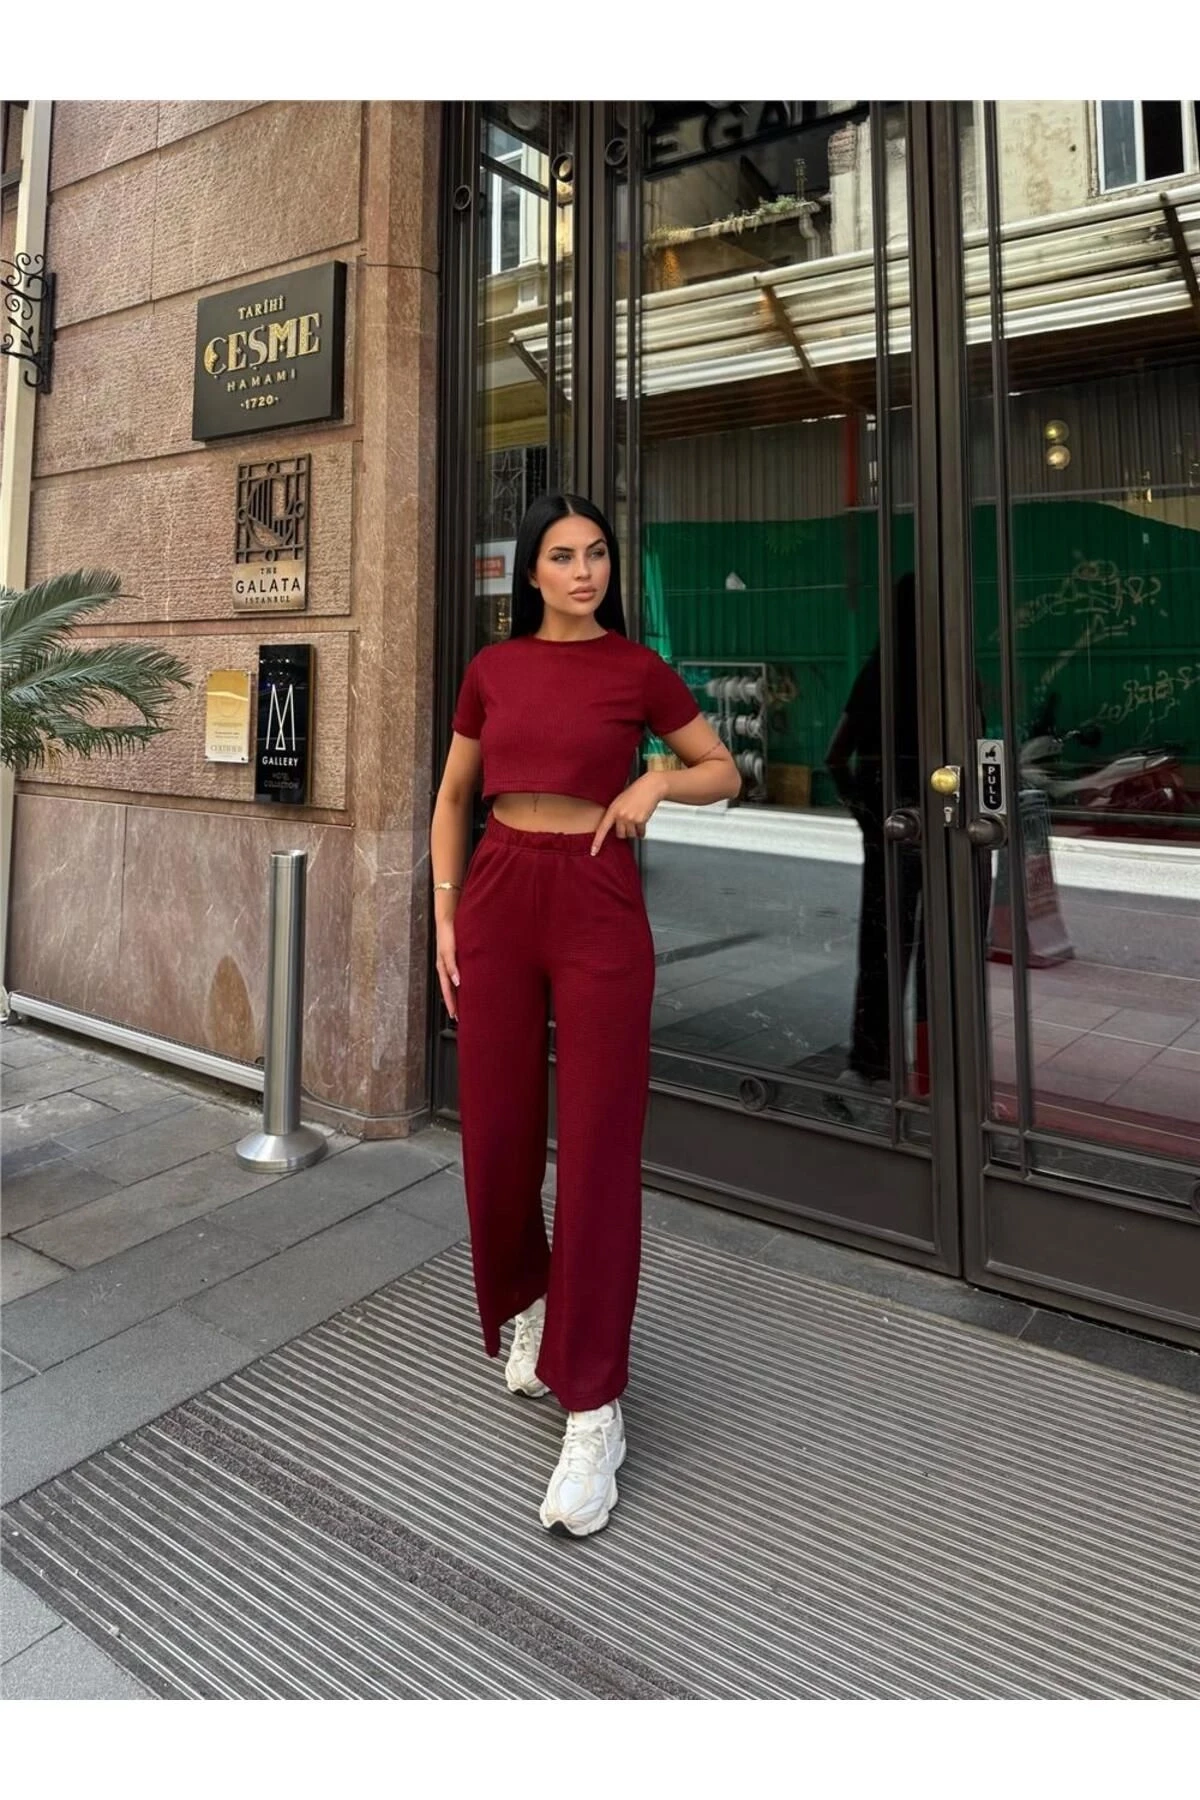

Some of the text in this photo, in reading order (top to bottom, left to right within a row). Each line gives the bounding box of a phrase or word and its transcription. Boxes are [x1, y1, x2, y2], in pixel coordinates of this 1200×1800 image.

[238, 295, 285, 320] TARİHİ
[203, 312, 321, 379] ÇEŞME
[227, 368, 297, 393] HAMAMI
[235, 577, 301, 594] GALATA
[262, 755, 299, 767] GALLERY
[987, 766, 997, 804] PULL
